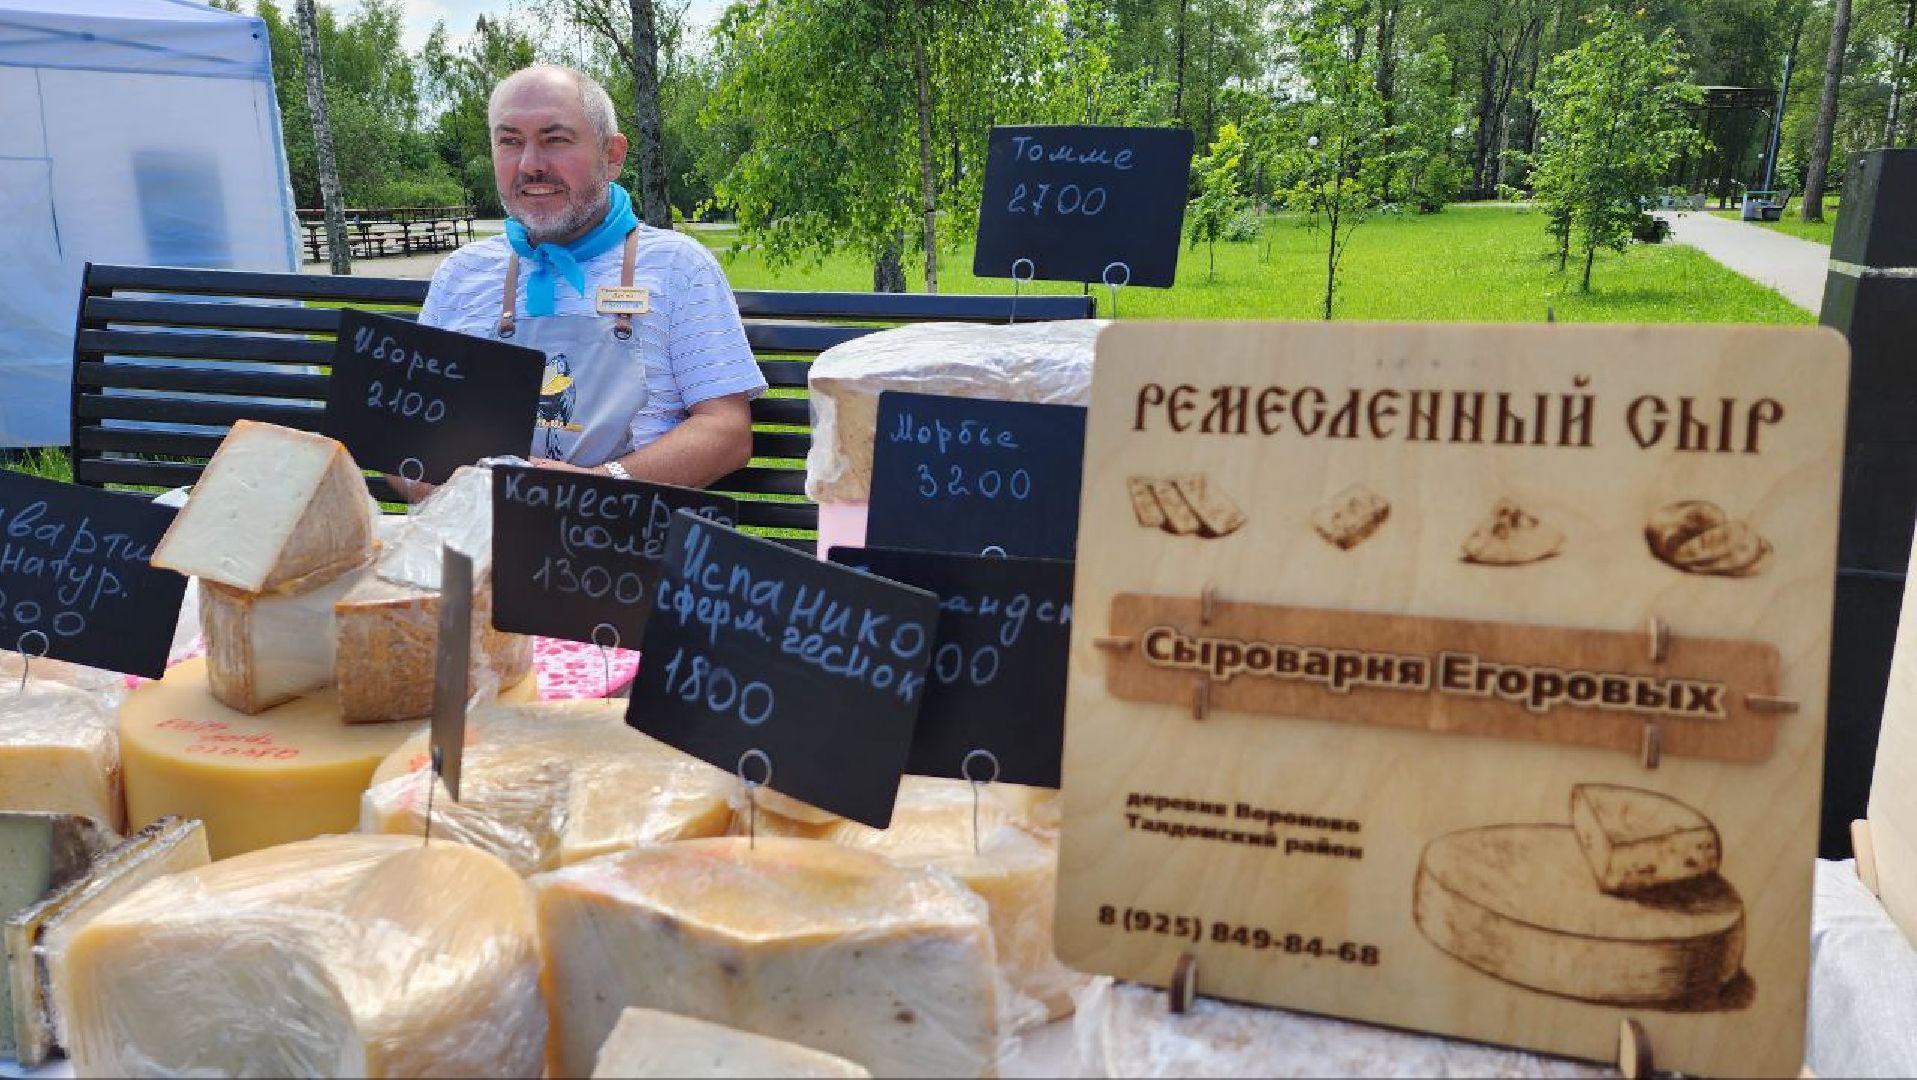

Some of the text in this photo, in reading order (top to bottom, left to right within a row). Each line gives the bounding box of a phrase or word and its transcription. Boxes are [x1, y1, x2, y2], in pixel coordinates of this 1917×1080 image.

[1012, 136, 1136, 170] Томме
[1008, 184, 1106, 215] 2700
[368, 380, 445, 422] 2100
[1131, 374, 1784, 454] РЕМЕСЛЕННЫЙ СЫР
[917, 464, 1031, 499] 3200
[0, 501, 151, 562] варти
[560, 516, 665, 559] (солё
[532, 556, 643, 604] 1300
[683, 523, 926, 657] Испанико
[663, 647, 775, 725] 1800
[1143, 628, 1727, 719] Сыроварня Егоровых
[1127, 792, 1361, 832] деревня Вороново
[1126, 813, 1364, 859] Талдомский район
[1098, 905, 1380, 965] 8 (925) 849-84-68
